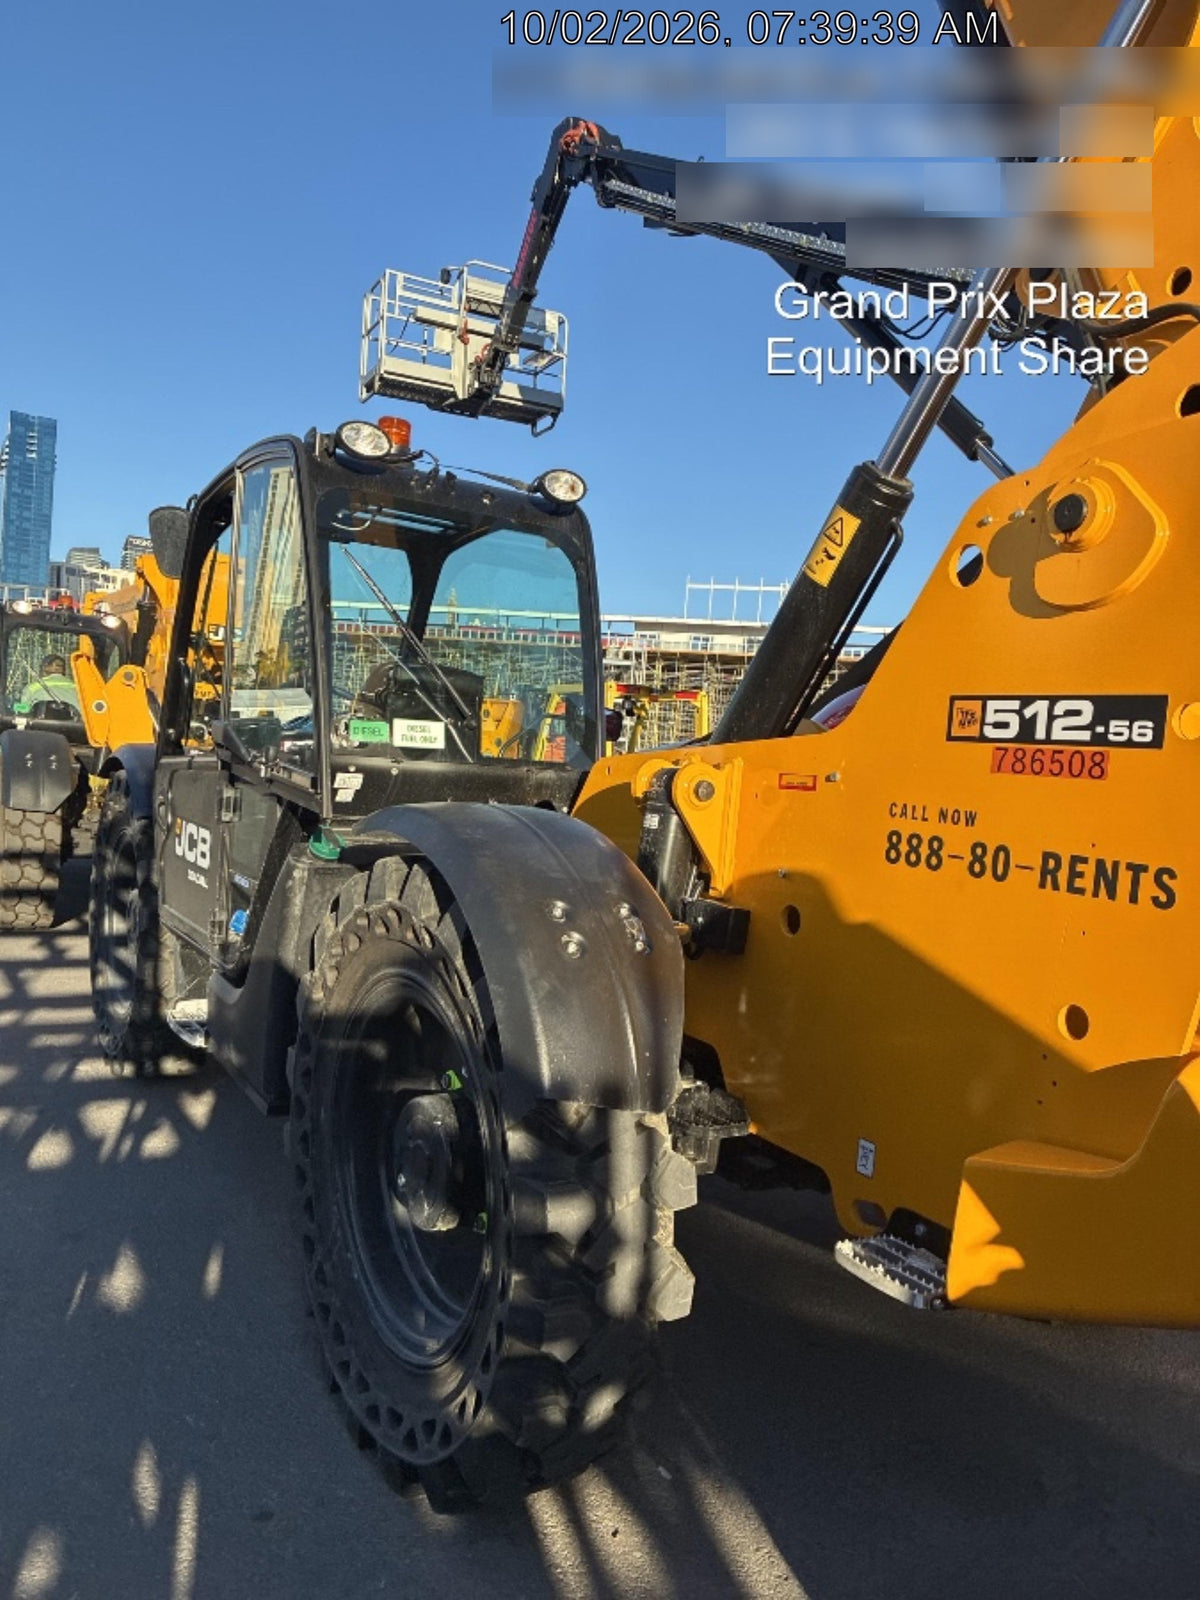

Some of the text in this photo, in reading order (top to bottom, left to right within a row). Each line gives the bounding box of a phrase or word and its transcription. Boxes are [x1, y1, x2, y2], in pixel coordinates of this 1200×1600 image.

[983, 699, 1154, 742] 512-56
[994, 747, 1106, 780] 786508
[889, 802, 977, 827] CALL NOW
[175, 819, 211, 869] JCB
